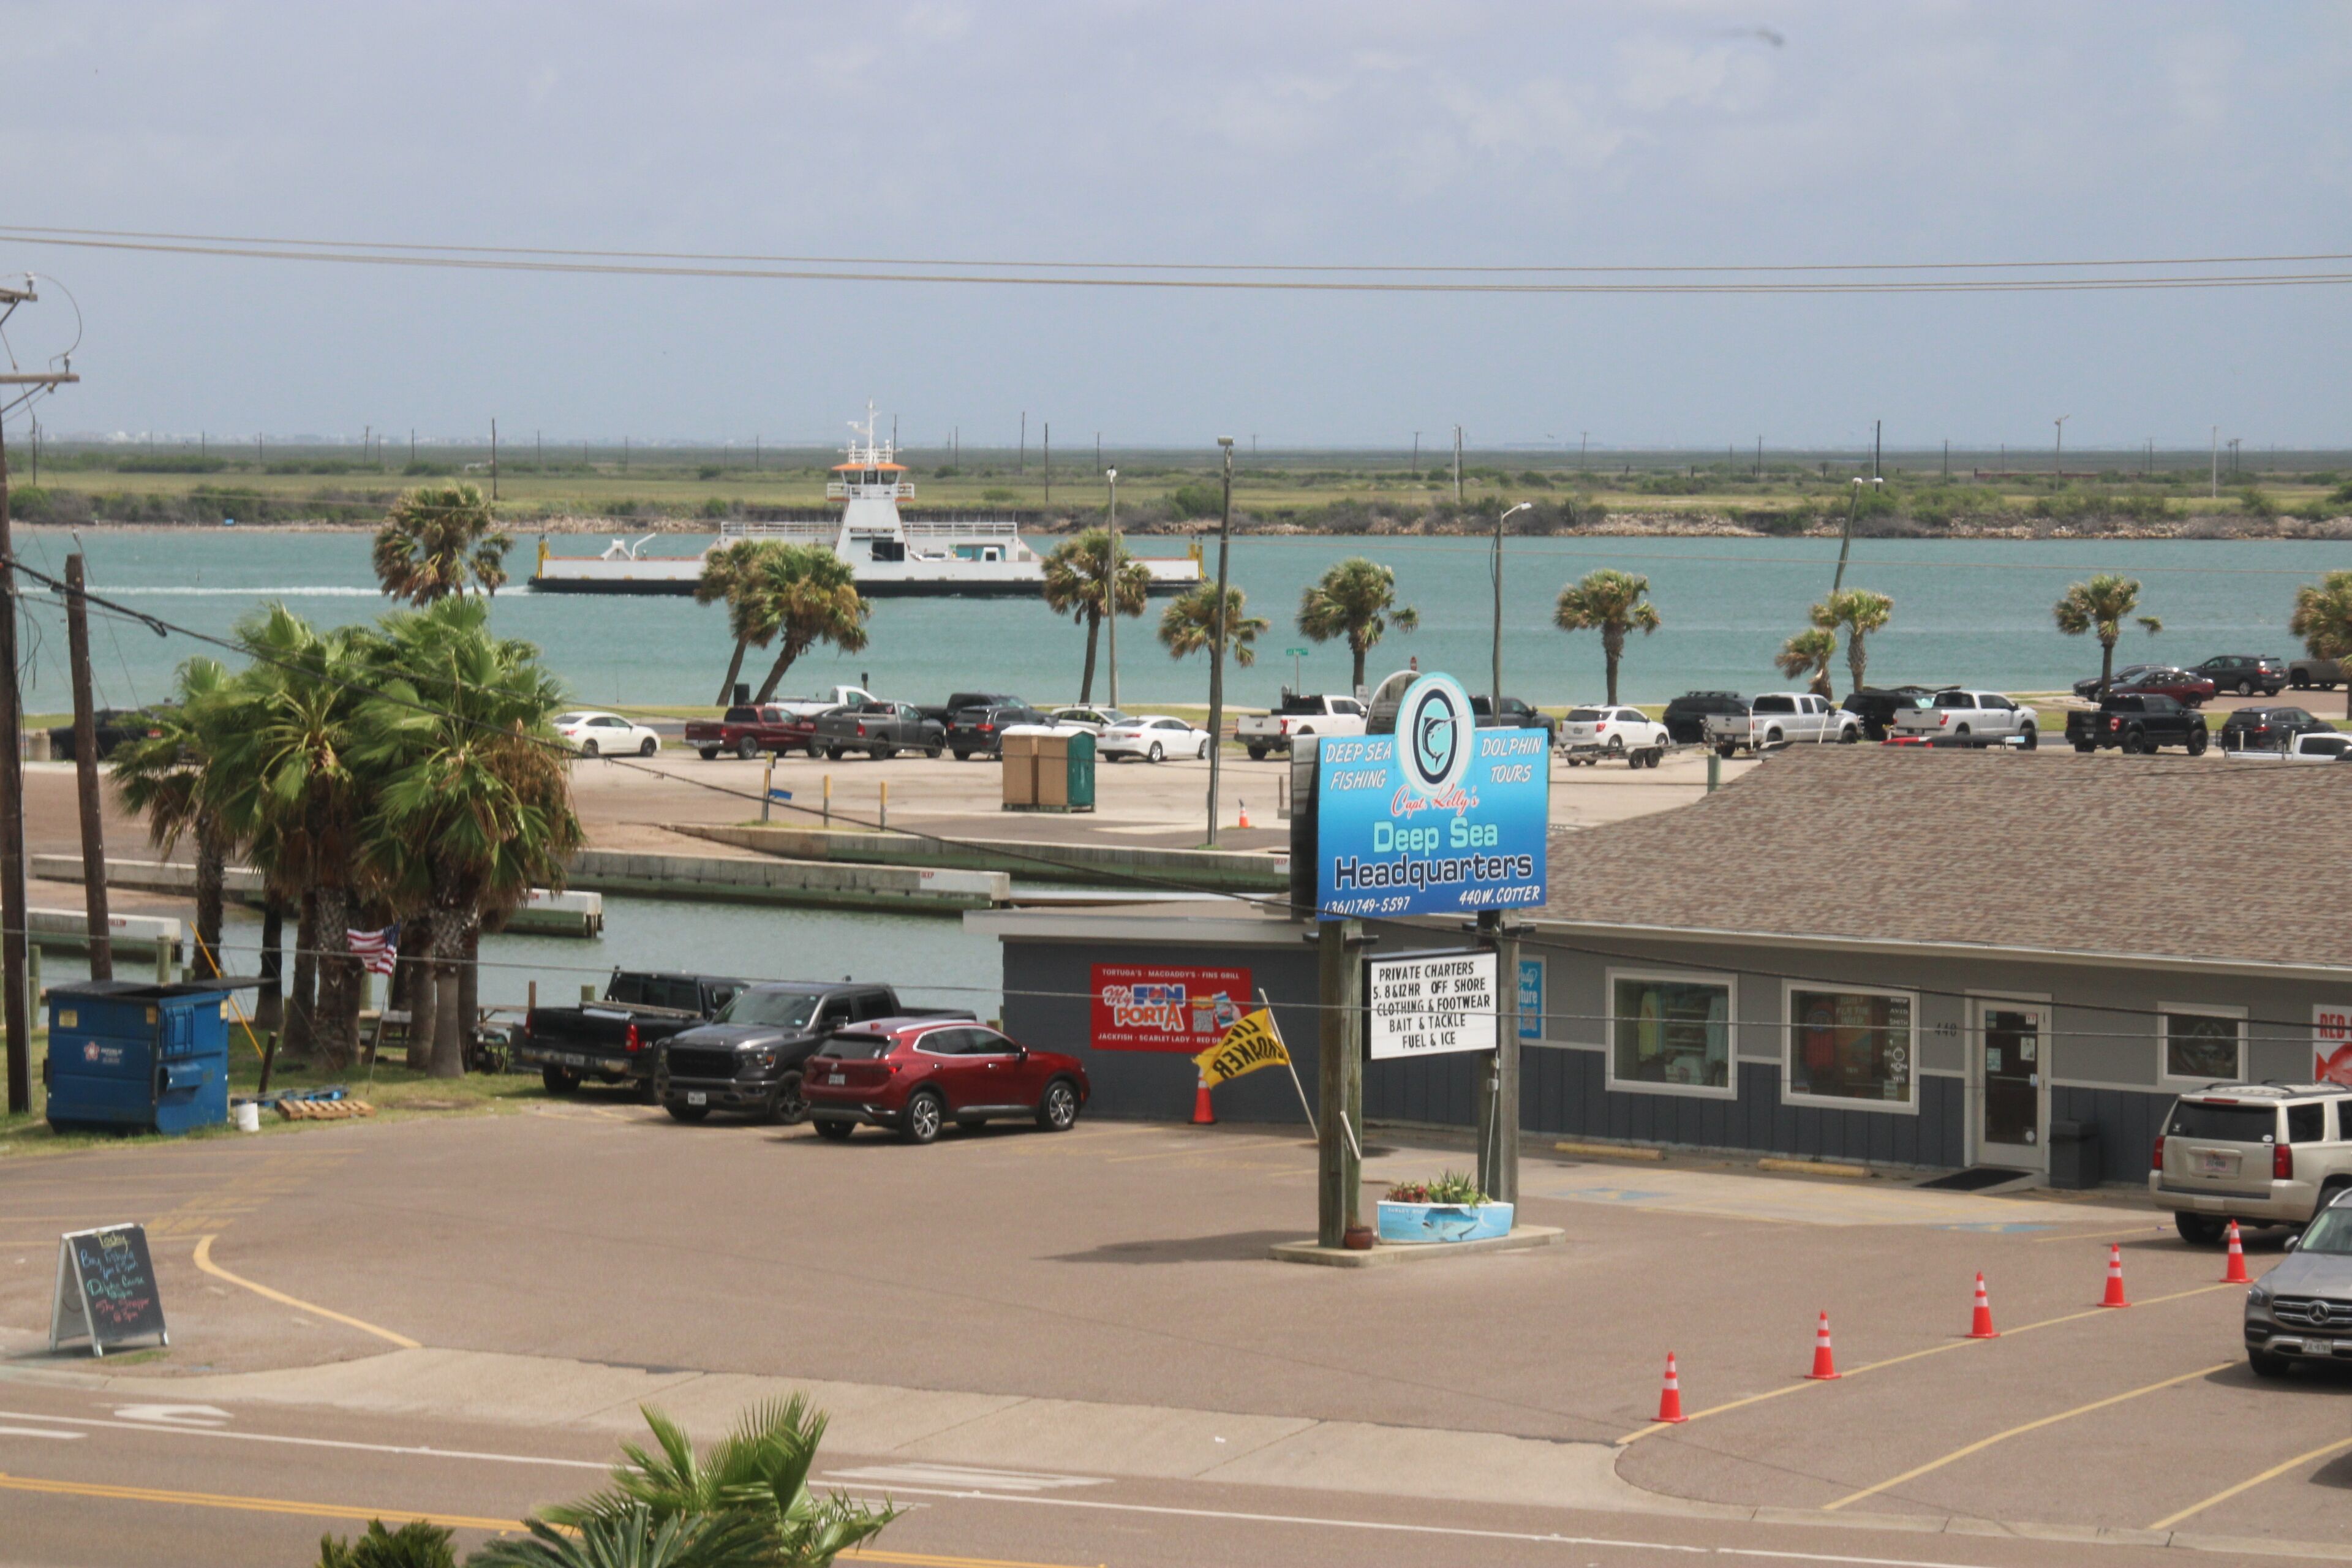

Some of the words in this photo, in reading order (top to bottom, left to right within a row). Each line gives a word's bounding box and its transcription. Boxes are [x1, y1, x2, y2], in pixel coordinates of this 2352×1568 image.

[1325, 742, 1363, 763] DEEP
[1365, 741, 1393, 761] SEA
[1481, 736, 1543, 757] DOLPHIN
[1330, 769, 1387, 791] FISHING
[1490, 764, 1532, 784] TOURS
[1391, 784, 1427, 820] Capt.
[1431, 783, 1480, 816] Kelly's
[1374, 820, 1439, 856] Deep
[1450, 816, 1498, 850] Sea
[1335, 853, 1533, 893] Headquarters
[1148, 970, 1196, 979] MACDADDY'S
[1379, 966, 1421, 982] PRIVATE
[1425, 961, 1474, 978] CHARTERS
[1103, 986, 1134, 1006] My
[1133, 985, 1185, 1006] FUN
[1431, 980, 1448, 994] OFF
[1454, 977, 1485, 992] SHORE
[1377, 1000, 1424, 1017] CLOTHING
[1428, 998, 1434, 1013] &
[1437, 994, 1490, 1012] FOOTWEAR
[1389, 1018, 1412, 1033] BAIT
[1419, 1017, 1425, 1030] &
[1428, 1014, 1466, 1029] TACKLE
[1935, 1022, 1958, 1036] 440
[2320, 1012, 2345, 1039] RED
[1139, 1034, 1170, 1042] SCARLET
[1403, 1033, 1427, 1049] FUEL
[1430, 1034, 1436, 1047] &
[1441, 1031, 1456, 1046] ICE
